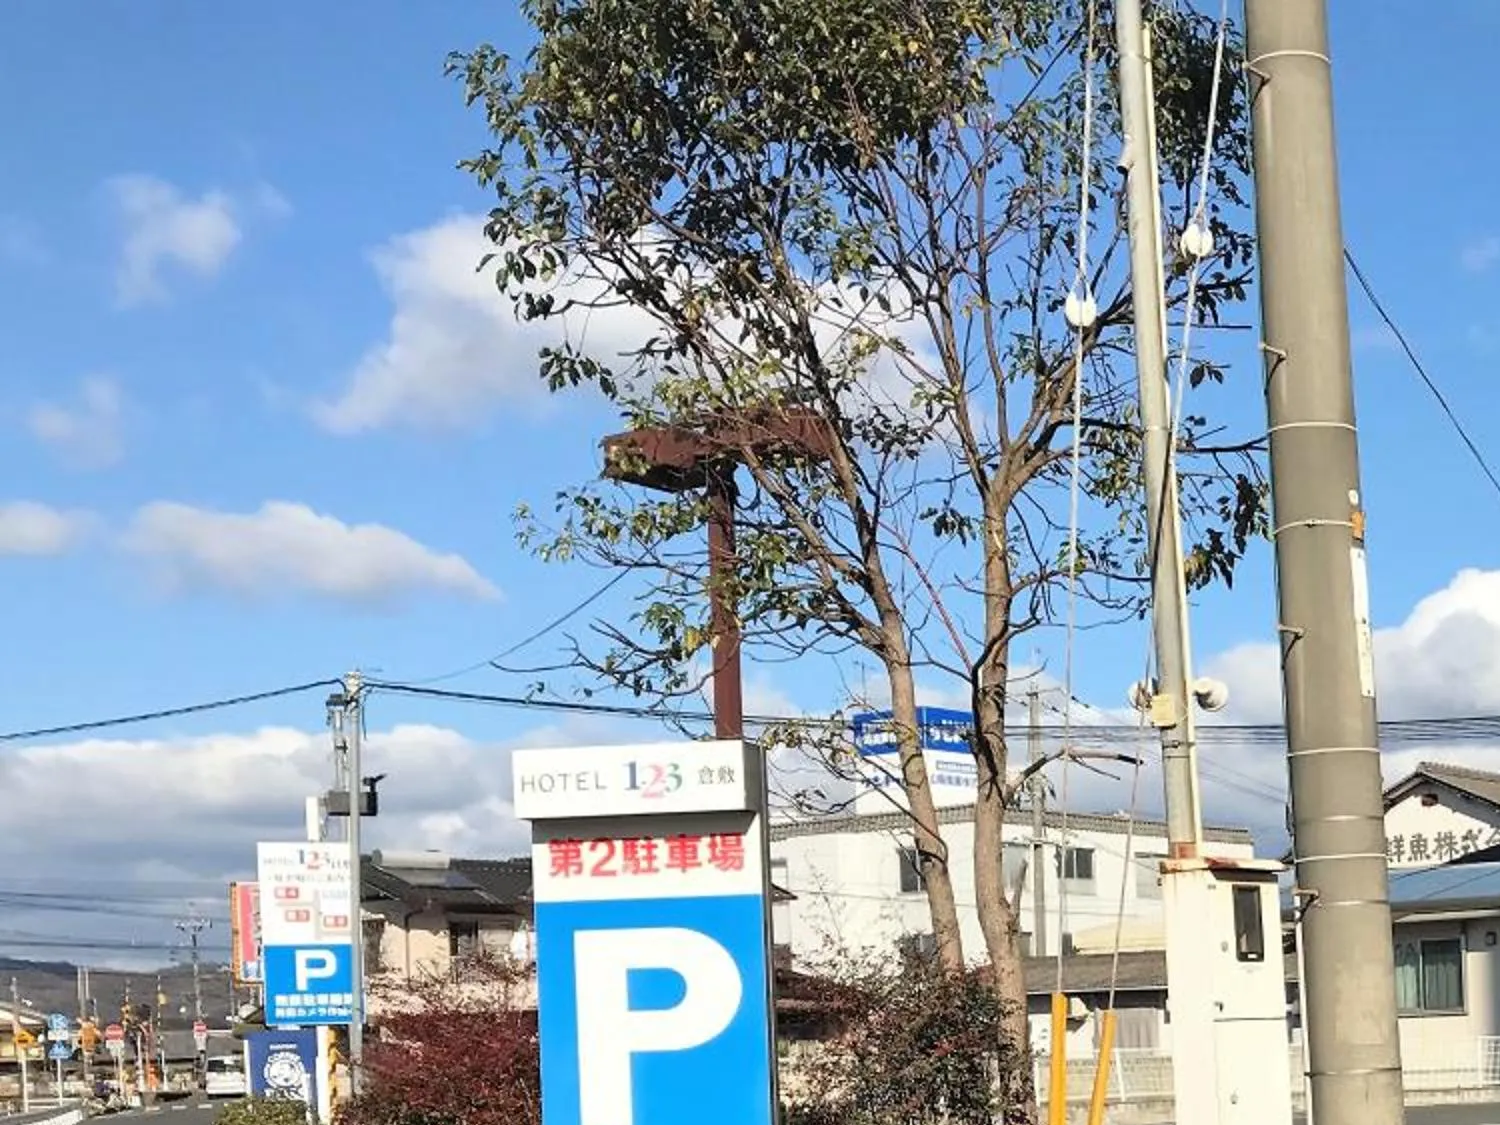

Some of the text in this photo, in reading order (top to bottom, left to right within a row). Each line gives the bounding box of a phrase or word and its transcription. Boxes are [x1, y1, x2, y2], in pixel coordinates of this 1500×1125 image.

[520, 771, 607, 793] HOTEL
[697, 765, 736, 785] 倉敷
[547, 831, 746, 878] 第2駐車場
[295, 949, 338, 992] P
